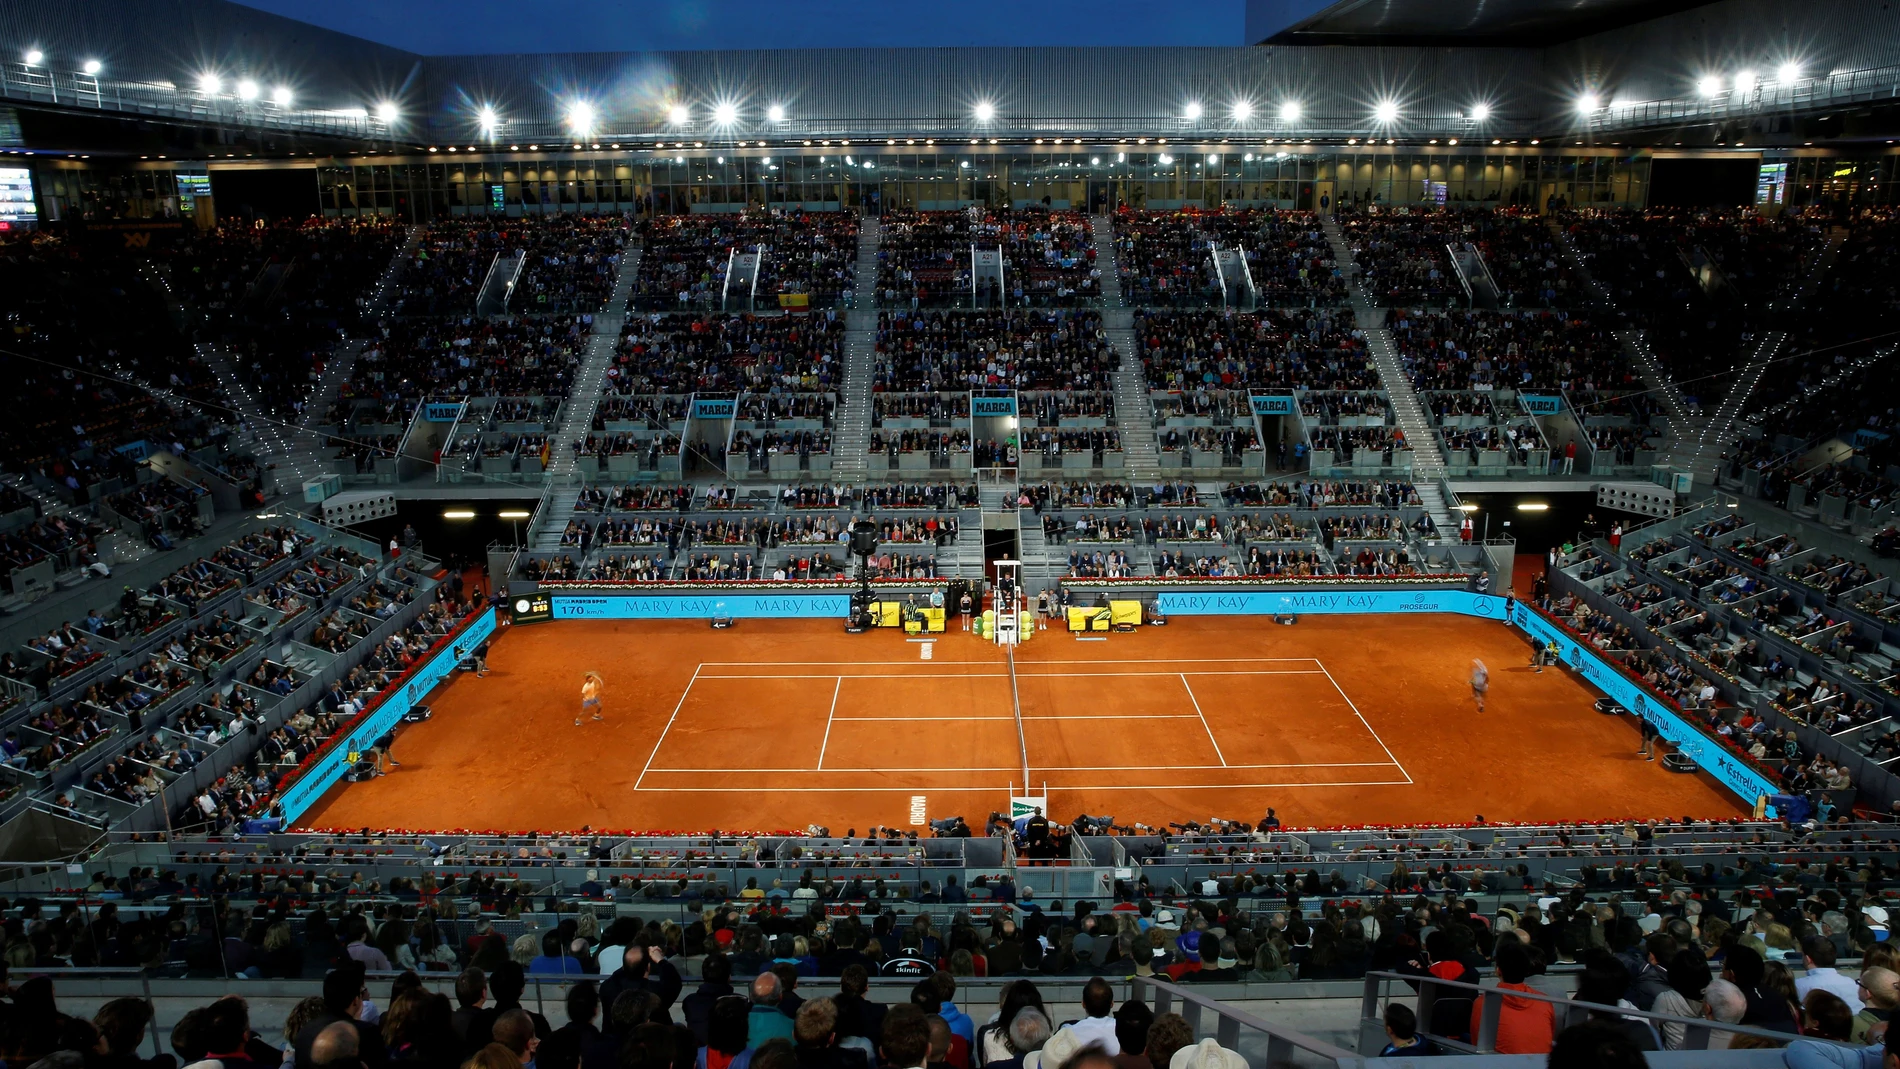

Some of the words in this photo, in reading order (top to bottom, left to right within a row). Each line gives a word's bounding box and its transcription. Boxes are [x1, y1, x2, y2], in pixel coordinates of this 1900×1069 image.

[699, 405, 733, 415] MARCA
[976, 402, 1011, 413] MARCA
[1253, 401, 1287, 411] MARCA
[625, 600, 674, 614] MARY
[680, 600, 712, 614] KAY
[754, 600, 804, 614] MARY
[811, 599, 843, 614] KAY
[1161, 596, 1211, 611] MARY
[1217, 596, 1250, 610] KAY
[1291, 595, 1341, 610] MARY
[1346, 595, 1379, 609] KAY
[561, 606, 584, 615] 170
[1726, 761, 1757, 795] Estrella
[910, 795, 926, 826] MADRID
